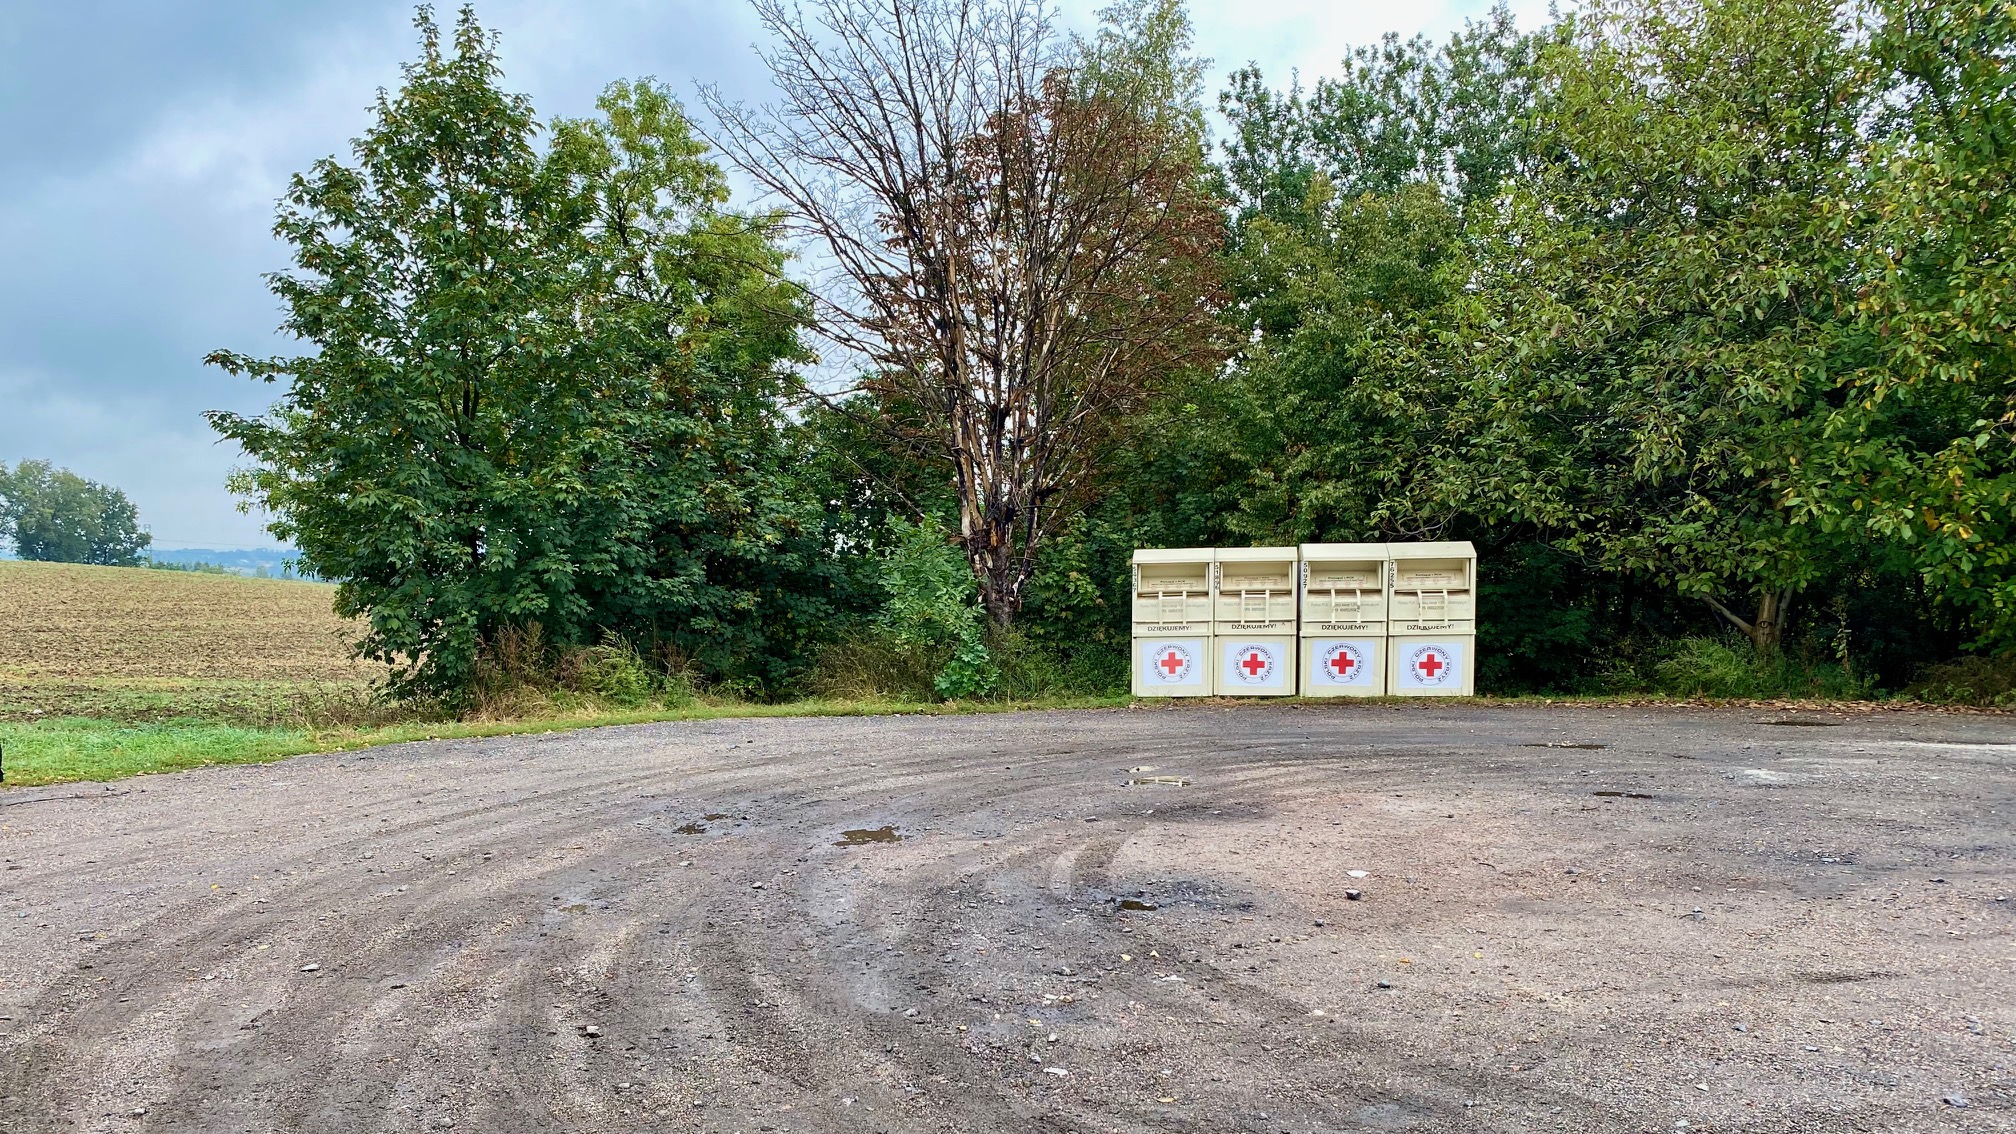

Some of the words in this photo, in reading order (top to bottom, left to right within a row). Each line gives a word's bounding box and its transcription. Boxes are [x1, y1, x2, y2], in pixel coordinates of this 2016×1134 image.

[1156, 645, 1190, 657] CZERWONY
[1238, 645, 1272, 660] CZERWONY
[1327, 644, 1361, 658] CZERWONY
[1414, 646, 1450, 660] CZERWONY
